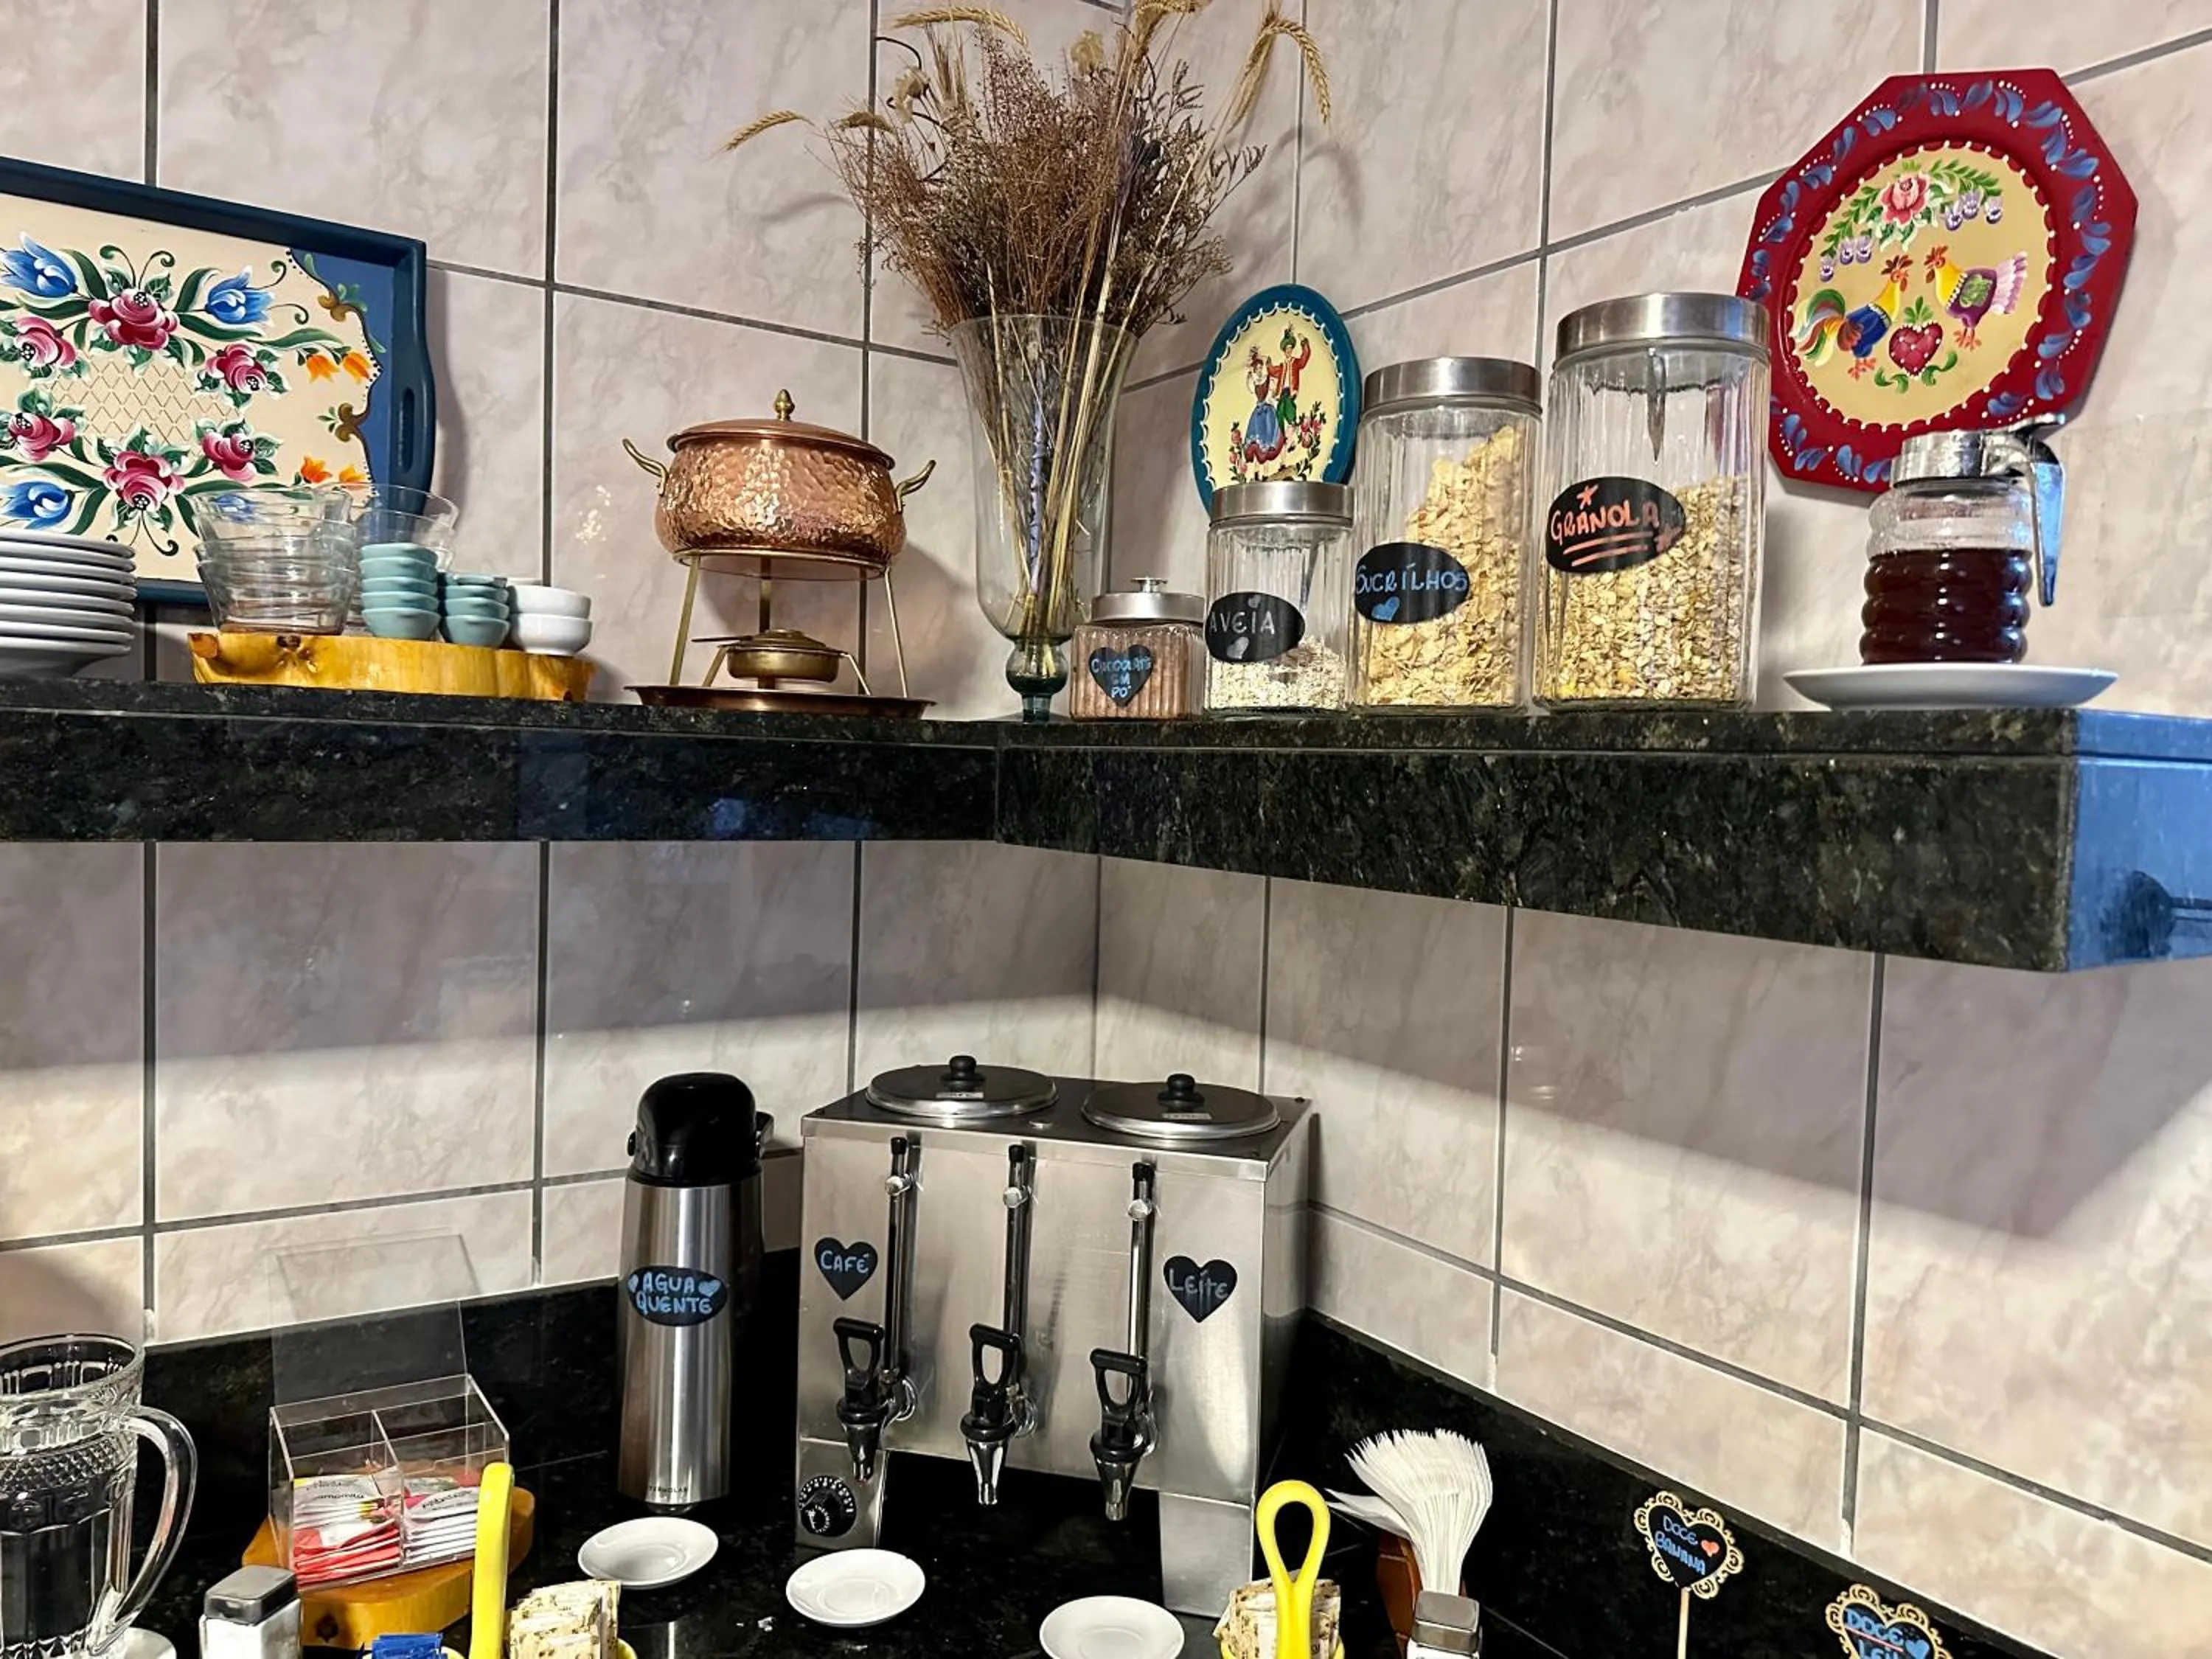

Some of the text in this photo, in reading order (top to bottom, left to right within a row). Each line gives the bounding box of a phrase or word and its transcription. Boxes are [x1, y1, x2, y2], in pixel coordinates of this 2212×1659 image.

[1551, 499, 1660, 546] GRANOLA
[1210, 610, 1276, 635] AVEIA
[820, 1249, 870, 1273] CAFÉ
[642, 1271, 695, 1294] AGUA
[636, 1290, 713, 1315] QUENTE
[1663, 1514, 1699, 1545] DOCE
[1845, 1608, 1905, 1646] DOCE
